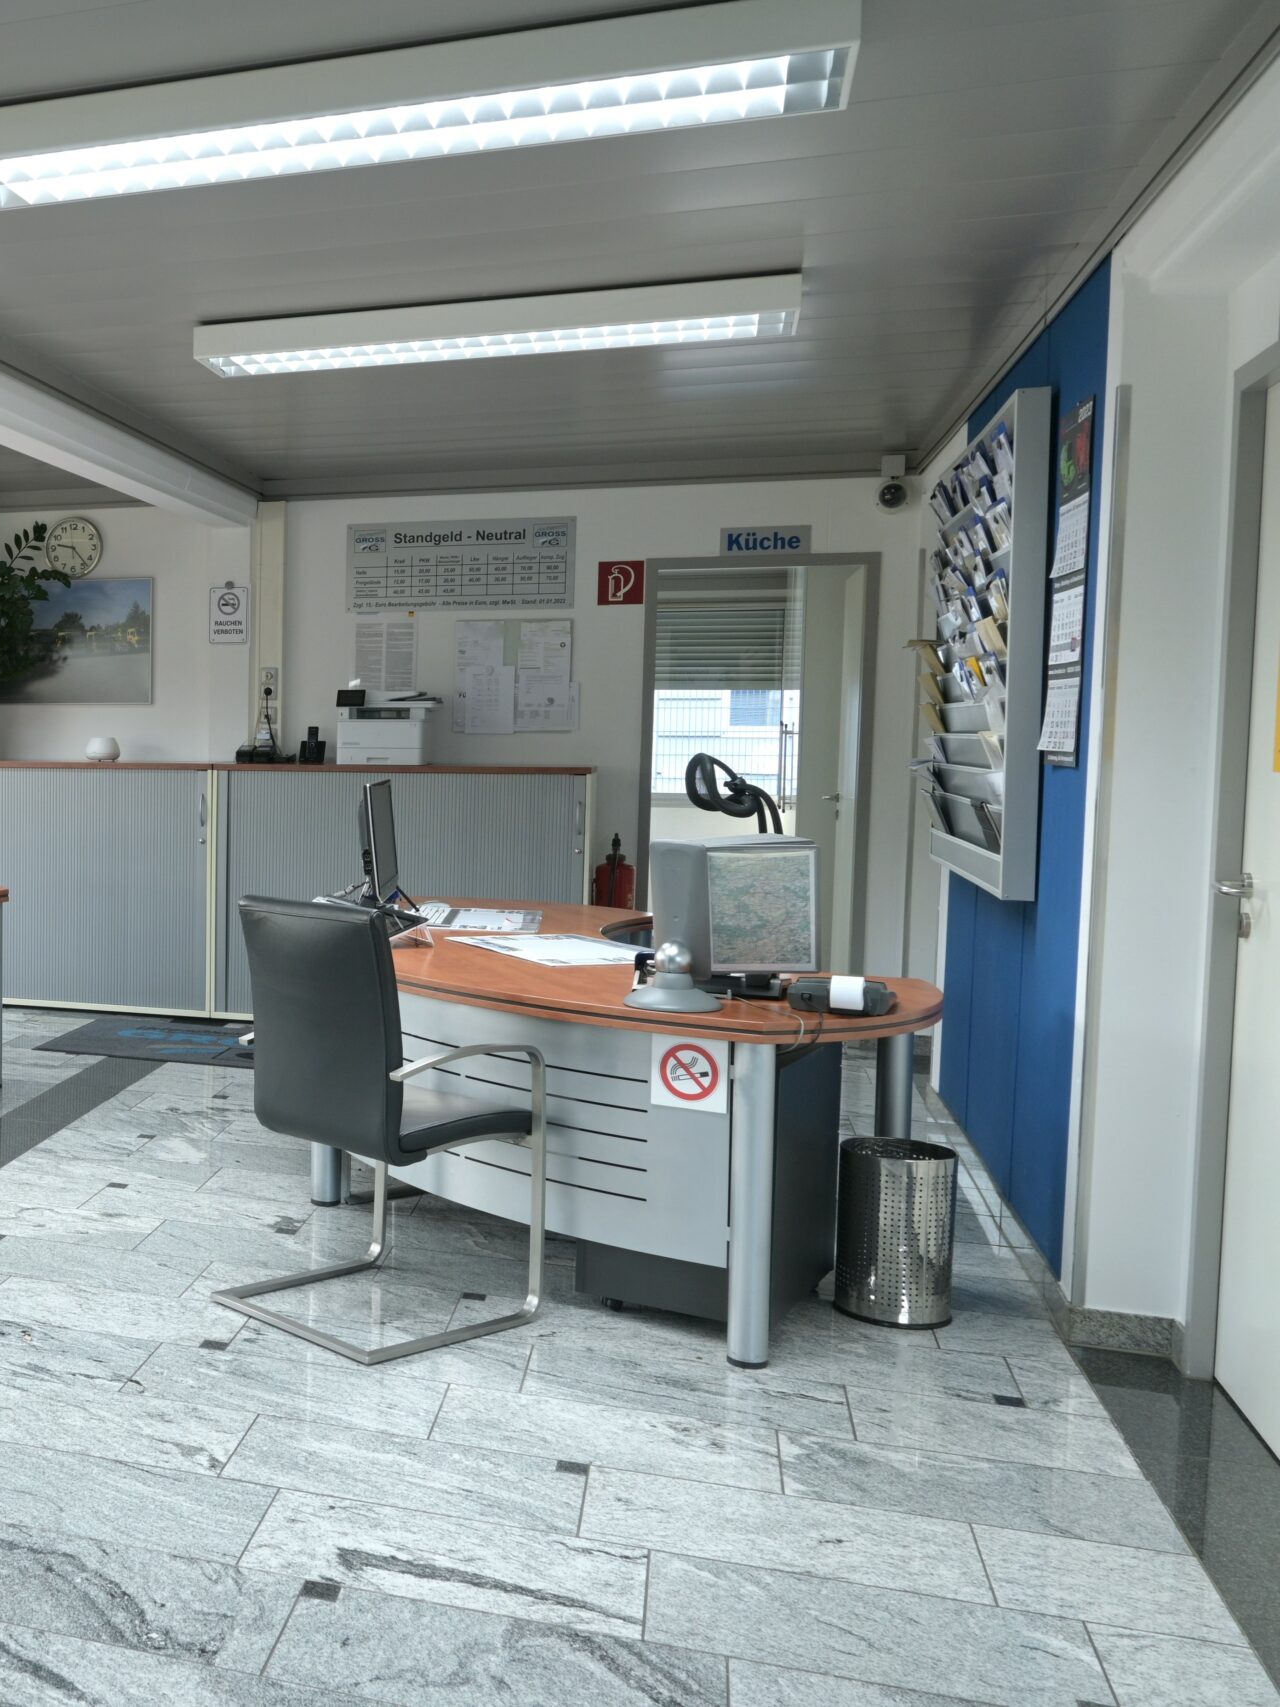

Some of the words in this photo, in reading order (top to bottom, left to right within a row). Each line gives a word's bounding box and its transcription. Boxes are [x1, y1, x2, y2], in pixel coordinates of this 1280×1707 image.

[393, 530, 463, 545] Standgeld
[476, 528, 526, 541] Neutral
[534, 530, 567, 538] GROSS
[355, 536, 385, 544] GROSS
[727, 531, 801, 552] Küche
[214, 619, 243, 627] RAUCHEN
[213, 628, 244, 636] VERBOTEN
